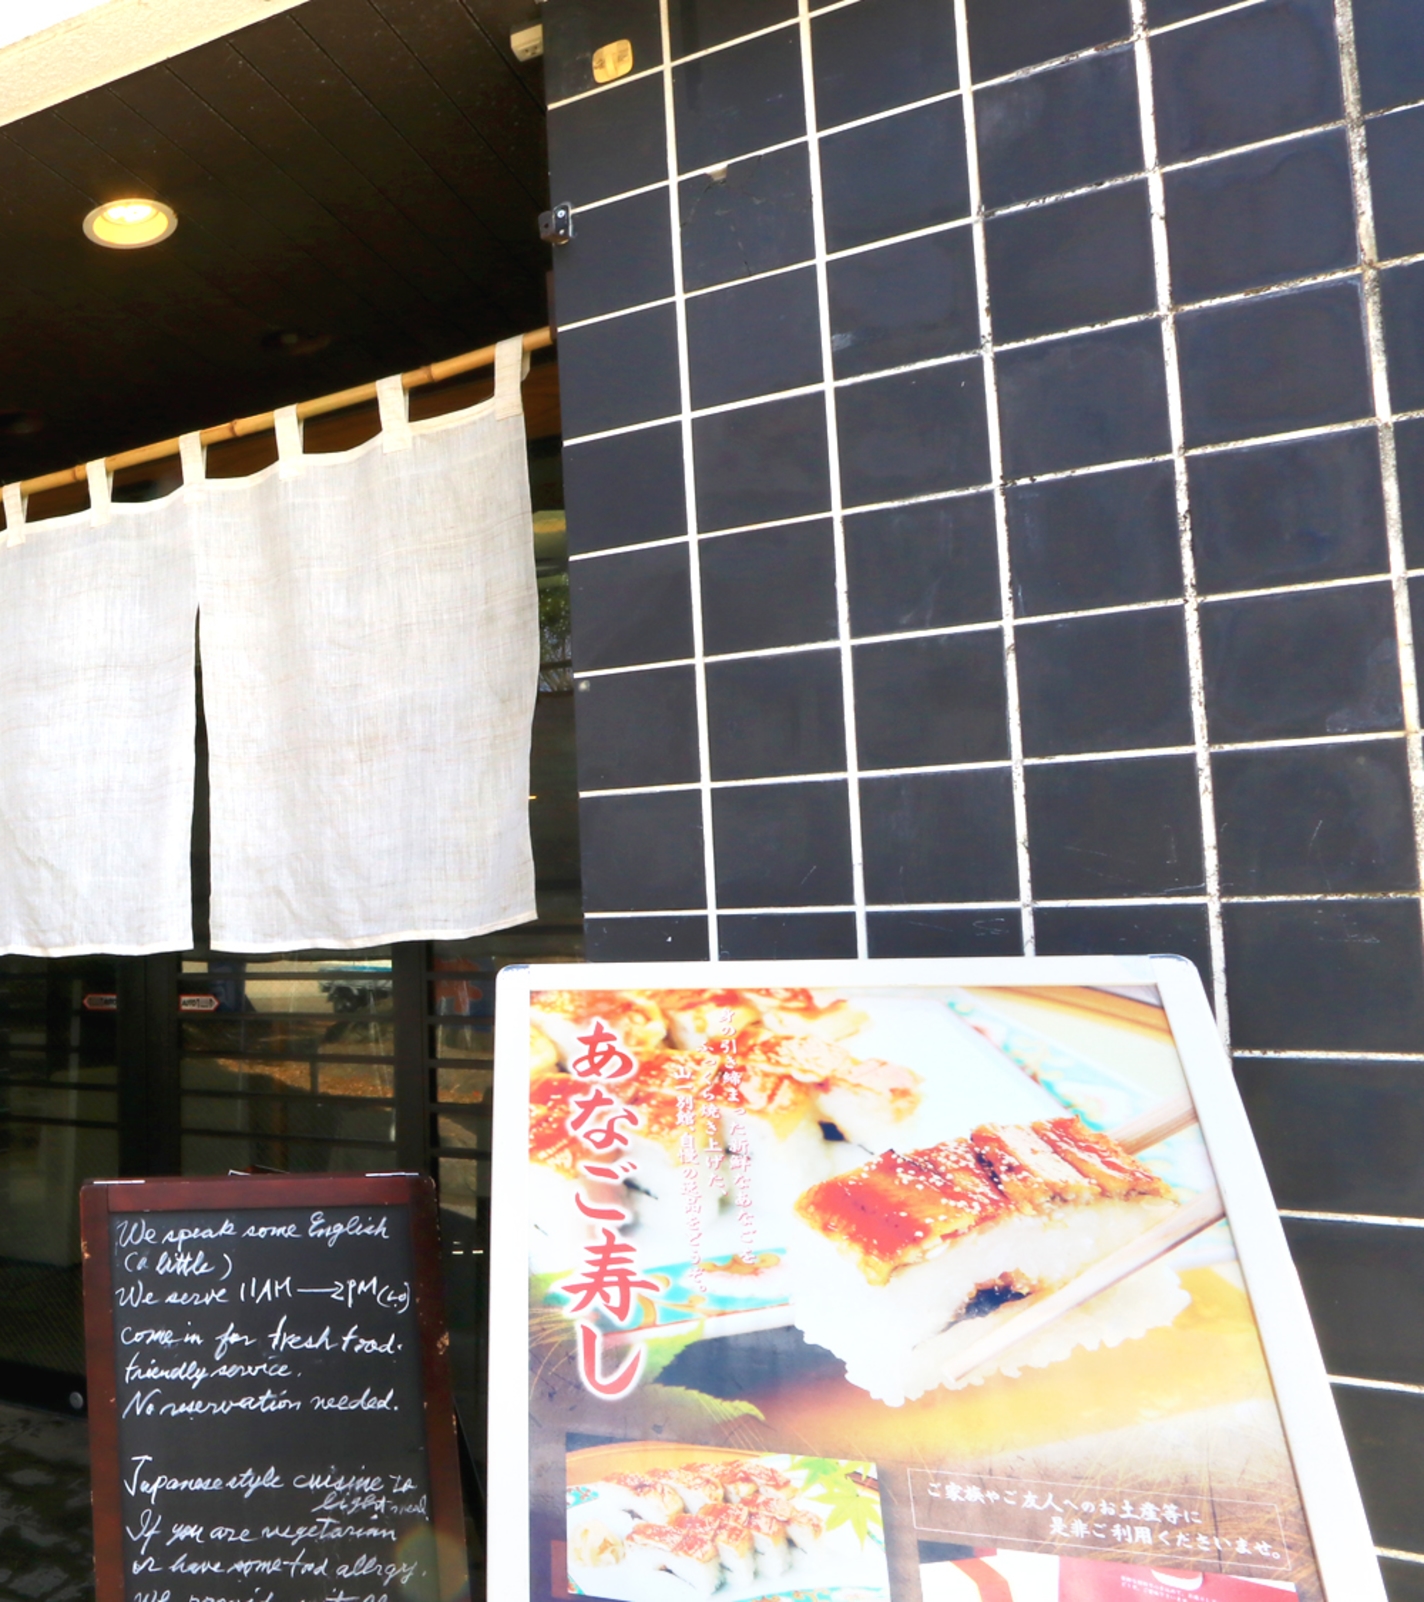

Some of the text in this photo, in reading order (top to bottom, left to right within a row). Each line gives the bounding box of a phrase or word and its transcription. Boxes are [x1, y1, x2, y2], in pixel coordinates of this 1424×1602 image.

[561, 1020, 660, 1396] あなご寿し
[116, 1211, 390, 1252] We speak some English
[115, 1279, 159, 1308] We
[165, 1287, 229, 1305] serve
[183, 1321, 204, 1345] in
[214, 1322, 257, 1360] for
[268, 1314, 338, 1352] fresh
[122, 1387, 399, 1419] No reservation needed.
[124, 1455, 223, 1505] Japanese
[225, 1466, 285, 1498] style
[293, 1465, 384, 1492] cuisine
[927, 1481, 1203, 1526] ご家族やご友人へのお土産等に
[126, 1508, 397, 1556] If you are vegetarian
[1049, 1516, 1281, 1560] 是非ご利用くださいませ。
[132, 1556, 163, 1575] or
[169, 1553, 226, 1575] have
[227, 1558, 283, 1578] some
